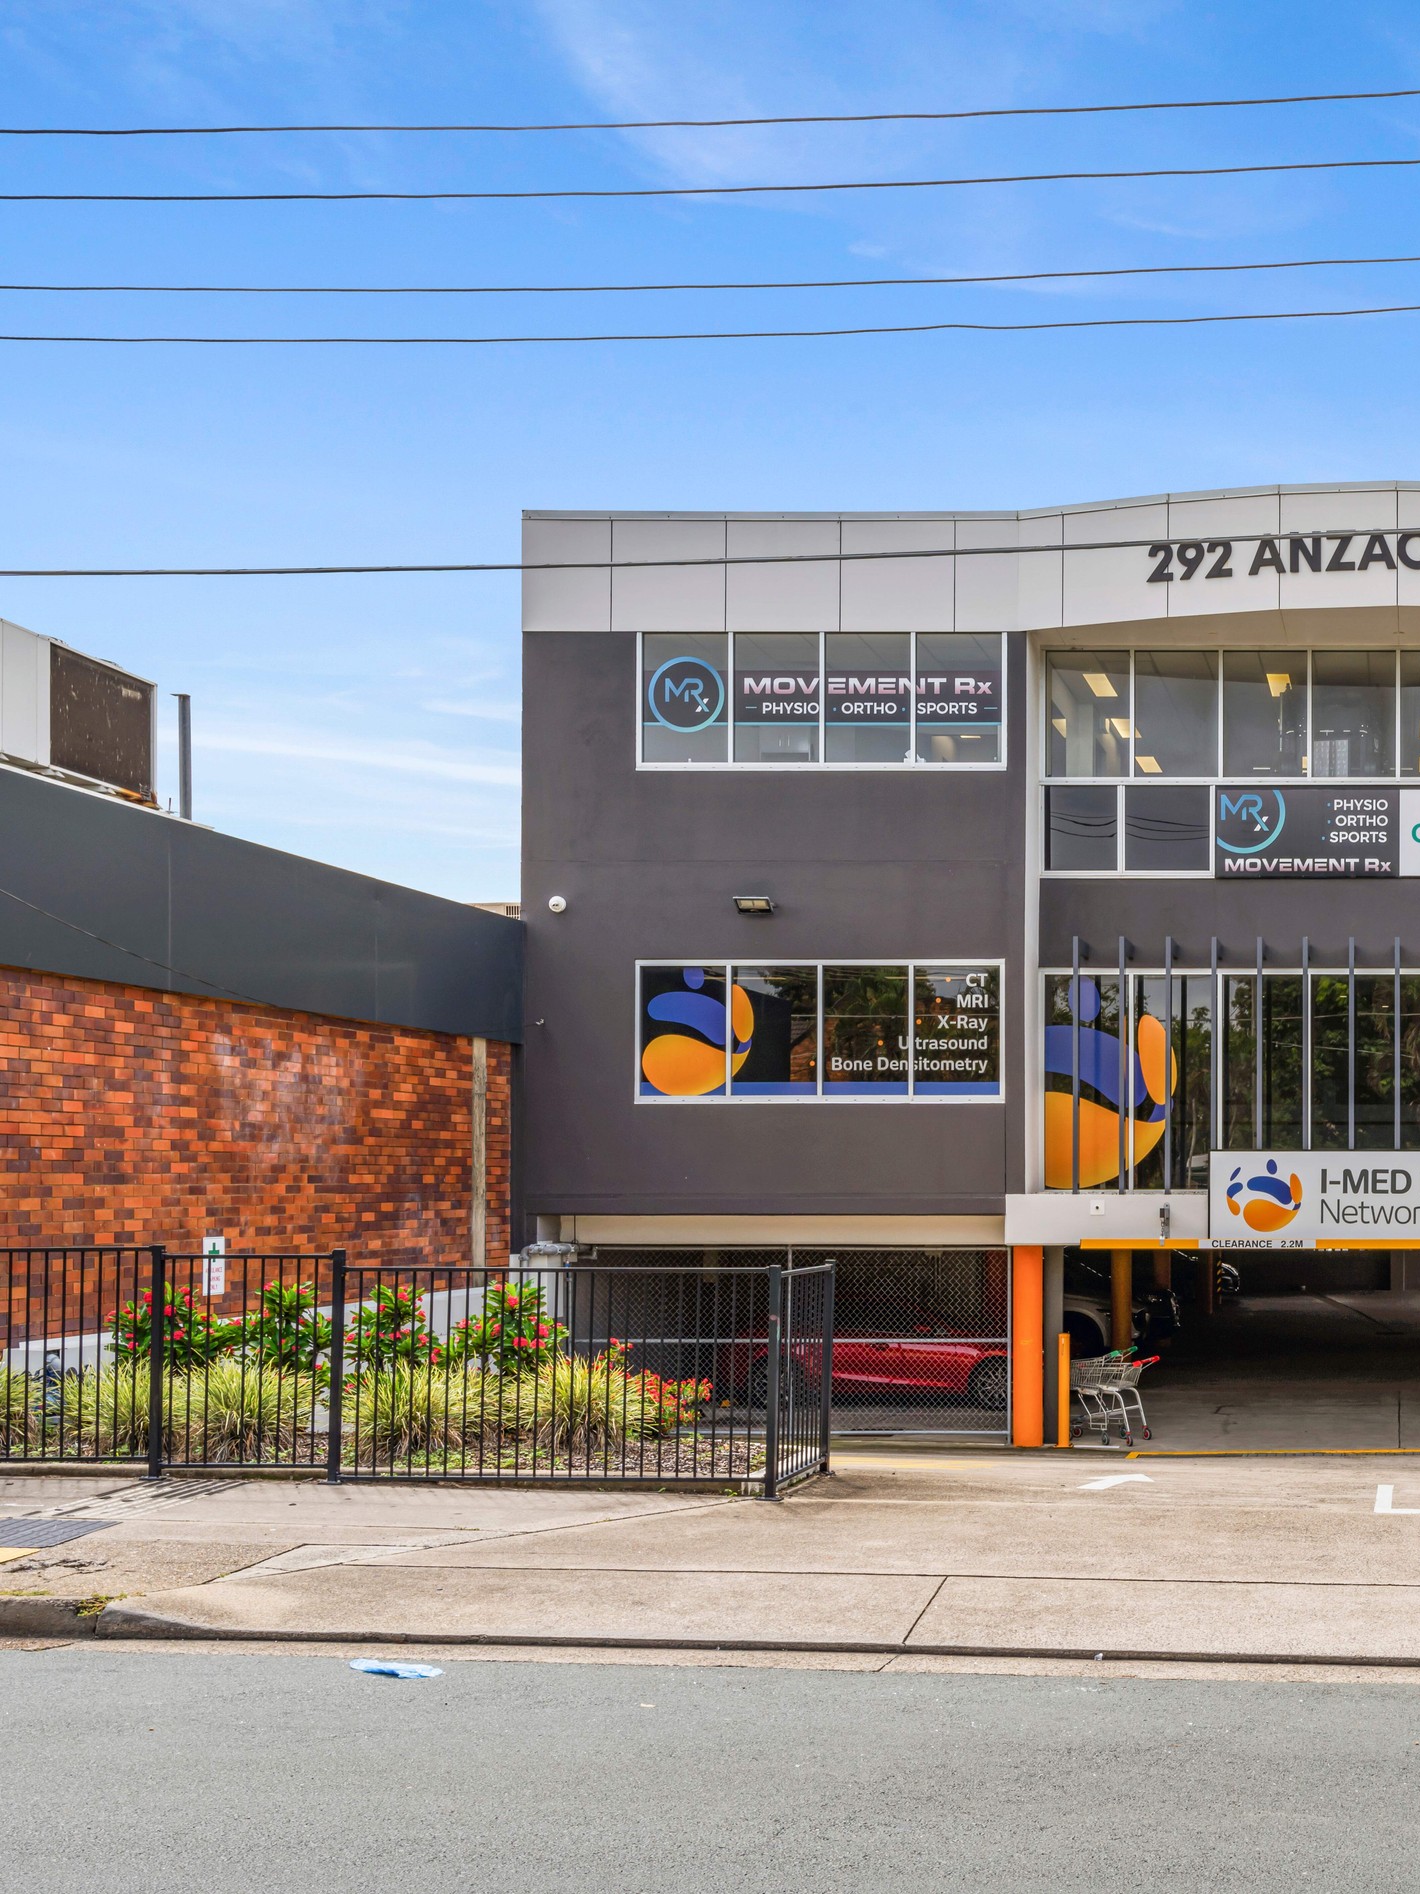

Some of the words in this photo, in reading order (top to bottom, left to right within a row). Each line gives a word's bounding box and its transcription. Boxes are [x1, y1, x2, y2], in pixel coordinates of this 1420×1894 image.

[1147, 540, 1233, 582] 292
[743, 677, 947, 695] MOVEMENT
[954, 677, 992, 695] Rx
[762, 702, 819, 715] PHYSIO
[841, 702, 898, 715] ORTHO
[917, 702, 978, 715] SPORTS
[1333, 799, 1388, 811] PHYSIO
[1335, 815, 1388, 827] ORTHO
[1329, 831, 1388, 843] SPORTS
[1224, 858, 1360, 872] MOVEMENT
[1364, 858, 1391, 872] Rx
[965, 973, 988, 987] CT
[956, 994, 989, 1008] MRI
[937, 1014, 988, 1031] X-Ray
[898, 1035, 988, 1050] Utrasound
[831, 1056, 873, 1071] Bone
[877, 1056, 988, 1073] Densitometry
[1320, 1168, 1412, 1194] I-MED
[1211, 1240, 1272, 1248] CLEARANCE
[1280, 1240, 1304, 1248] 2.2M
